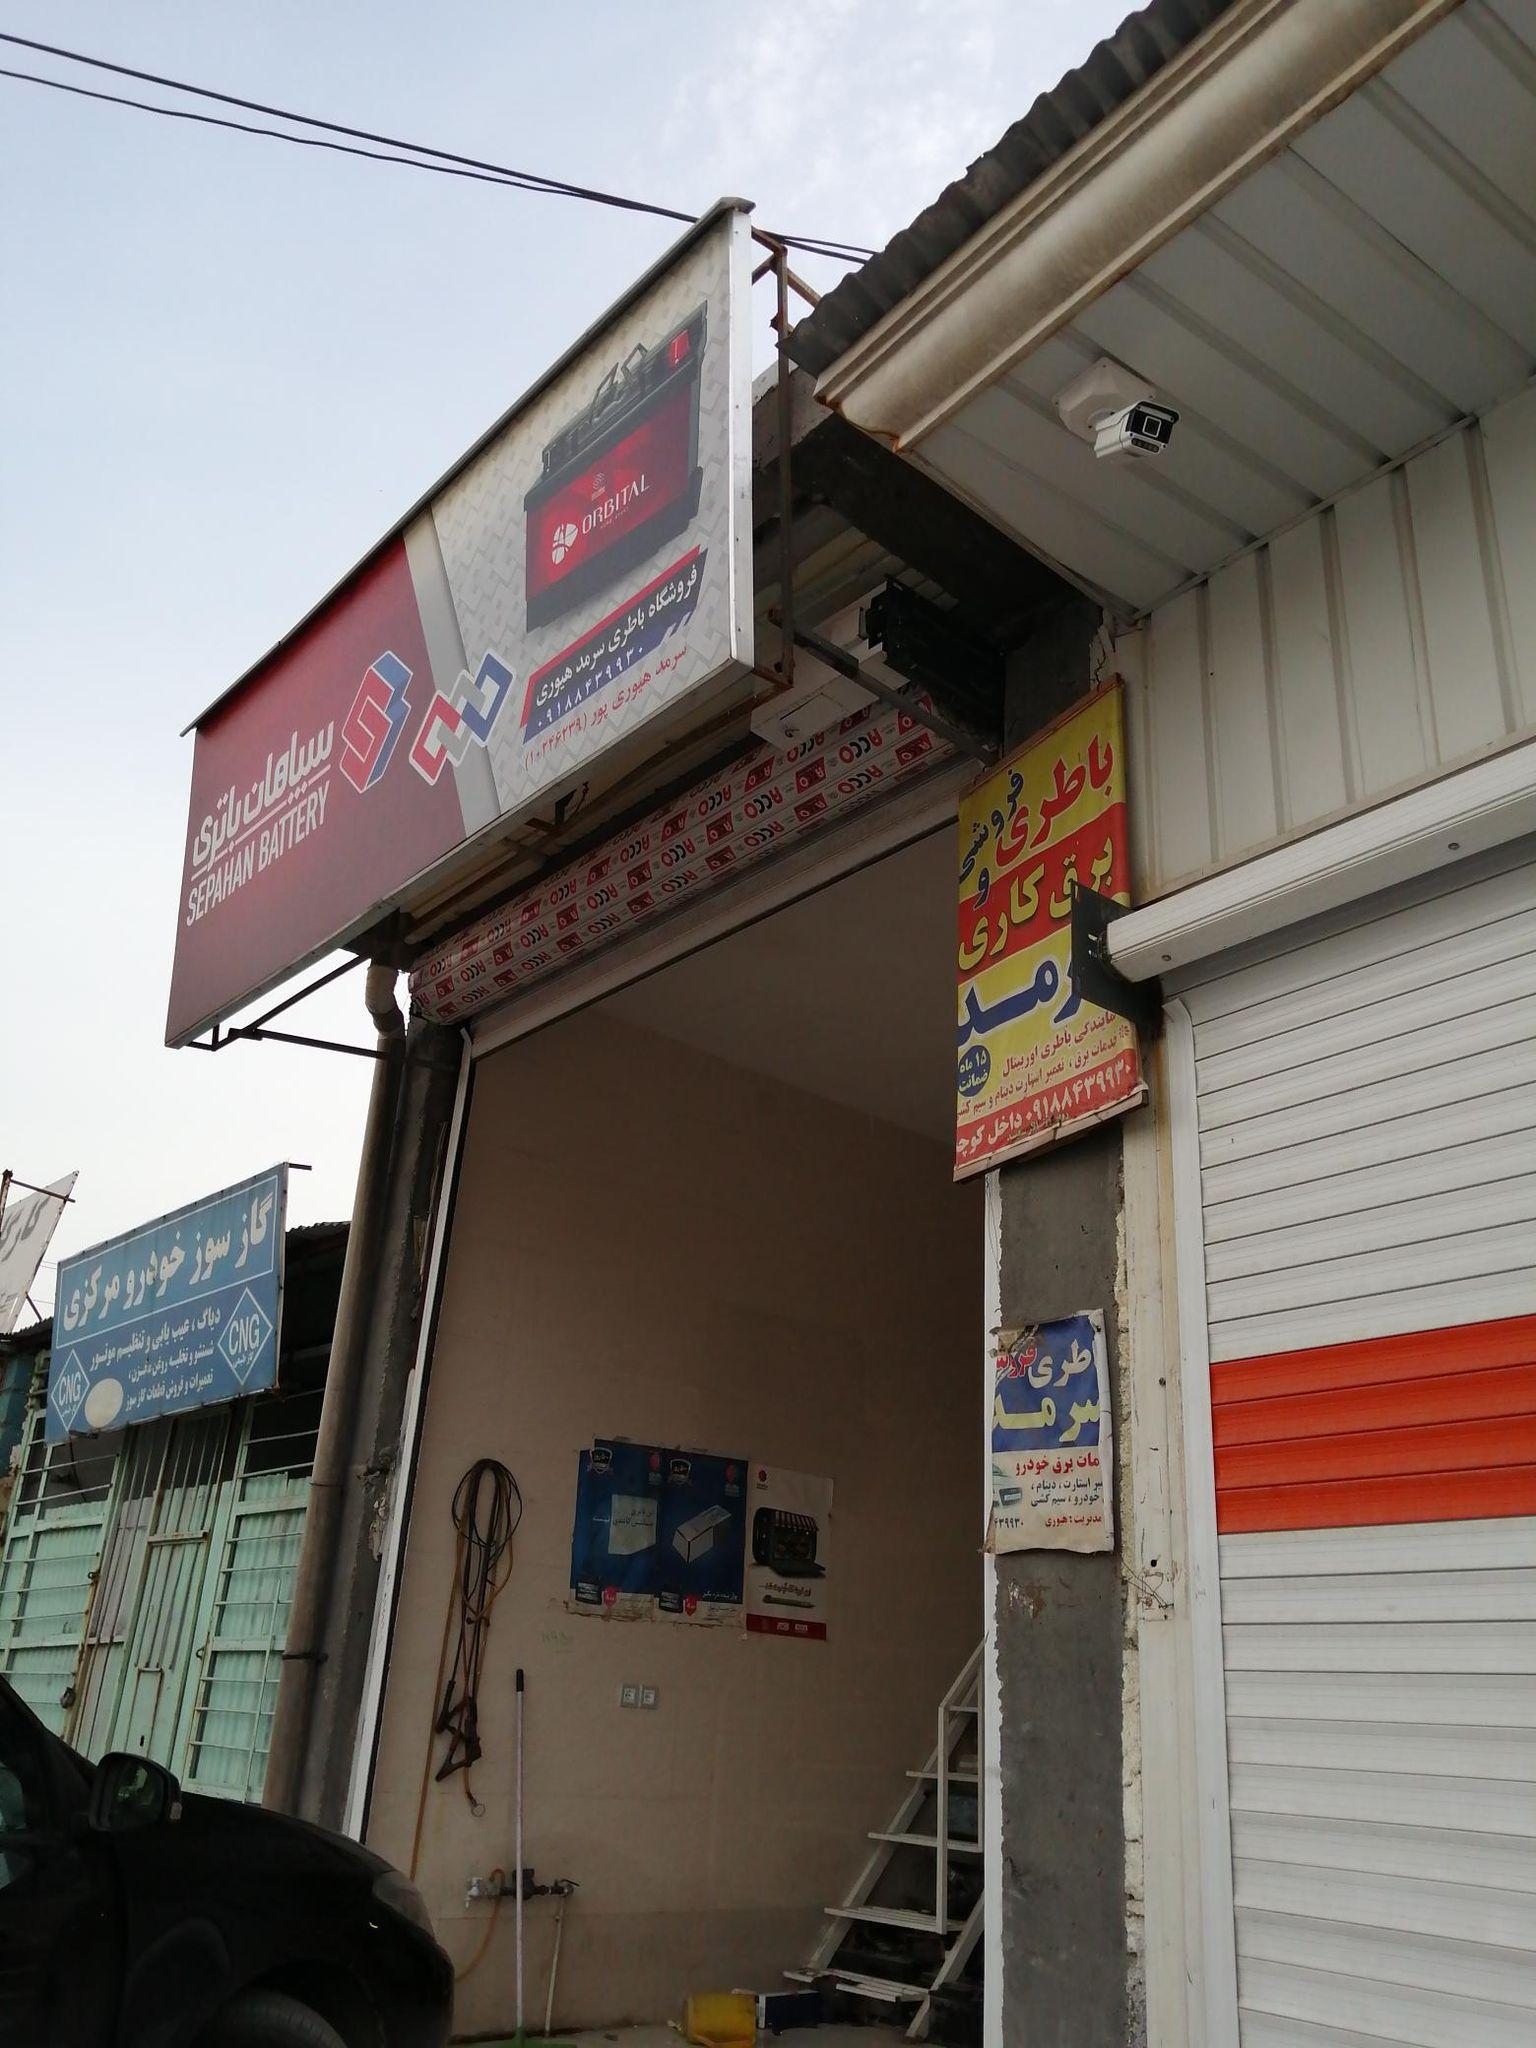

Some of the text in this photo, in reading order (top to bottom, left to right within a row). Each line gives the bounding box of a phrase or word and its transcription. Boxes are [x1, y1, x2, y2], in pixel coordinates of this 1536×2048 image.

[581, 474, 651, 536] ORBITAL
[536, 563, 698, 706] فروشگاه باطری سرمد هیوری
[655, 645, 687, 677] سرمد
[838, 764, 883, 793] ACCO
[192, 721, 334, 873] سپاهان باتری
[699, 785, 731, 816] ACCO
[996, 733, 1114, 867] باطری
[621, 834, 649, 863] ACCO
[743, 821, 784, 847] ACCO
[186, 780, 330, 927] SEPAHAN BATTERY
[461, 728, 882, 981] ACCO ACCO ACCO ACCO ACCO ACCO
[661, 870, 698, 893] ACCO
[587, 912, 620, 933] ACCO
[959, 862, 1044, 970] کاری
[958, 960, 1081, 1046] رمد
[1041, 1029, 1071, 1059] باطری
[988, 1112, 1024, 1144] داخل
[62, 1191, 273, 1331] گاز سوز خودرو مرکزی
[117, 1330, 145, 1361] تنظیم
[229, 1313, 260, 1356] CNG
[90, 1343, 116, 1371] موتور
[1028, 1339, 1091, 1389] طری
[59, 1371, 82, 1406] CNG
[1015, 1452, 1100, 1477] مات برق خودرو
[1036, 1479, 1056, 1493] دینام
[1064, 1477, 1090, 1492] استارت
[1074, 1493, 1100, 1507] خودرو
[1051, 1496, 1066, 1507] سیم
